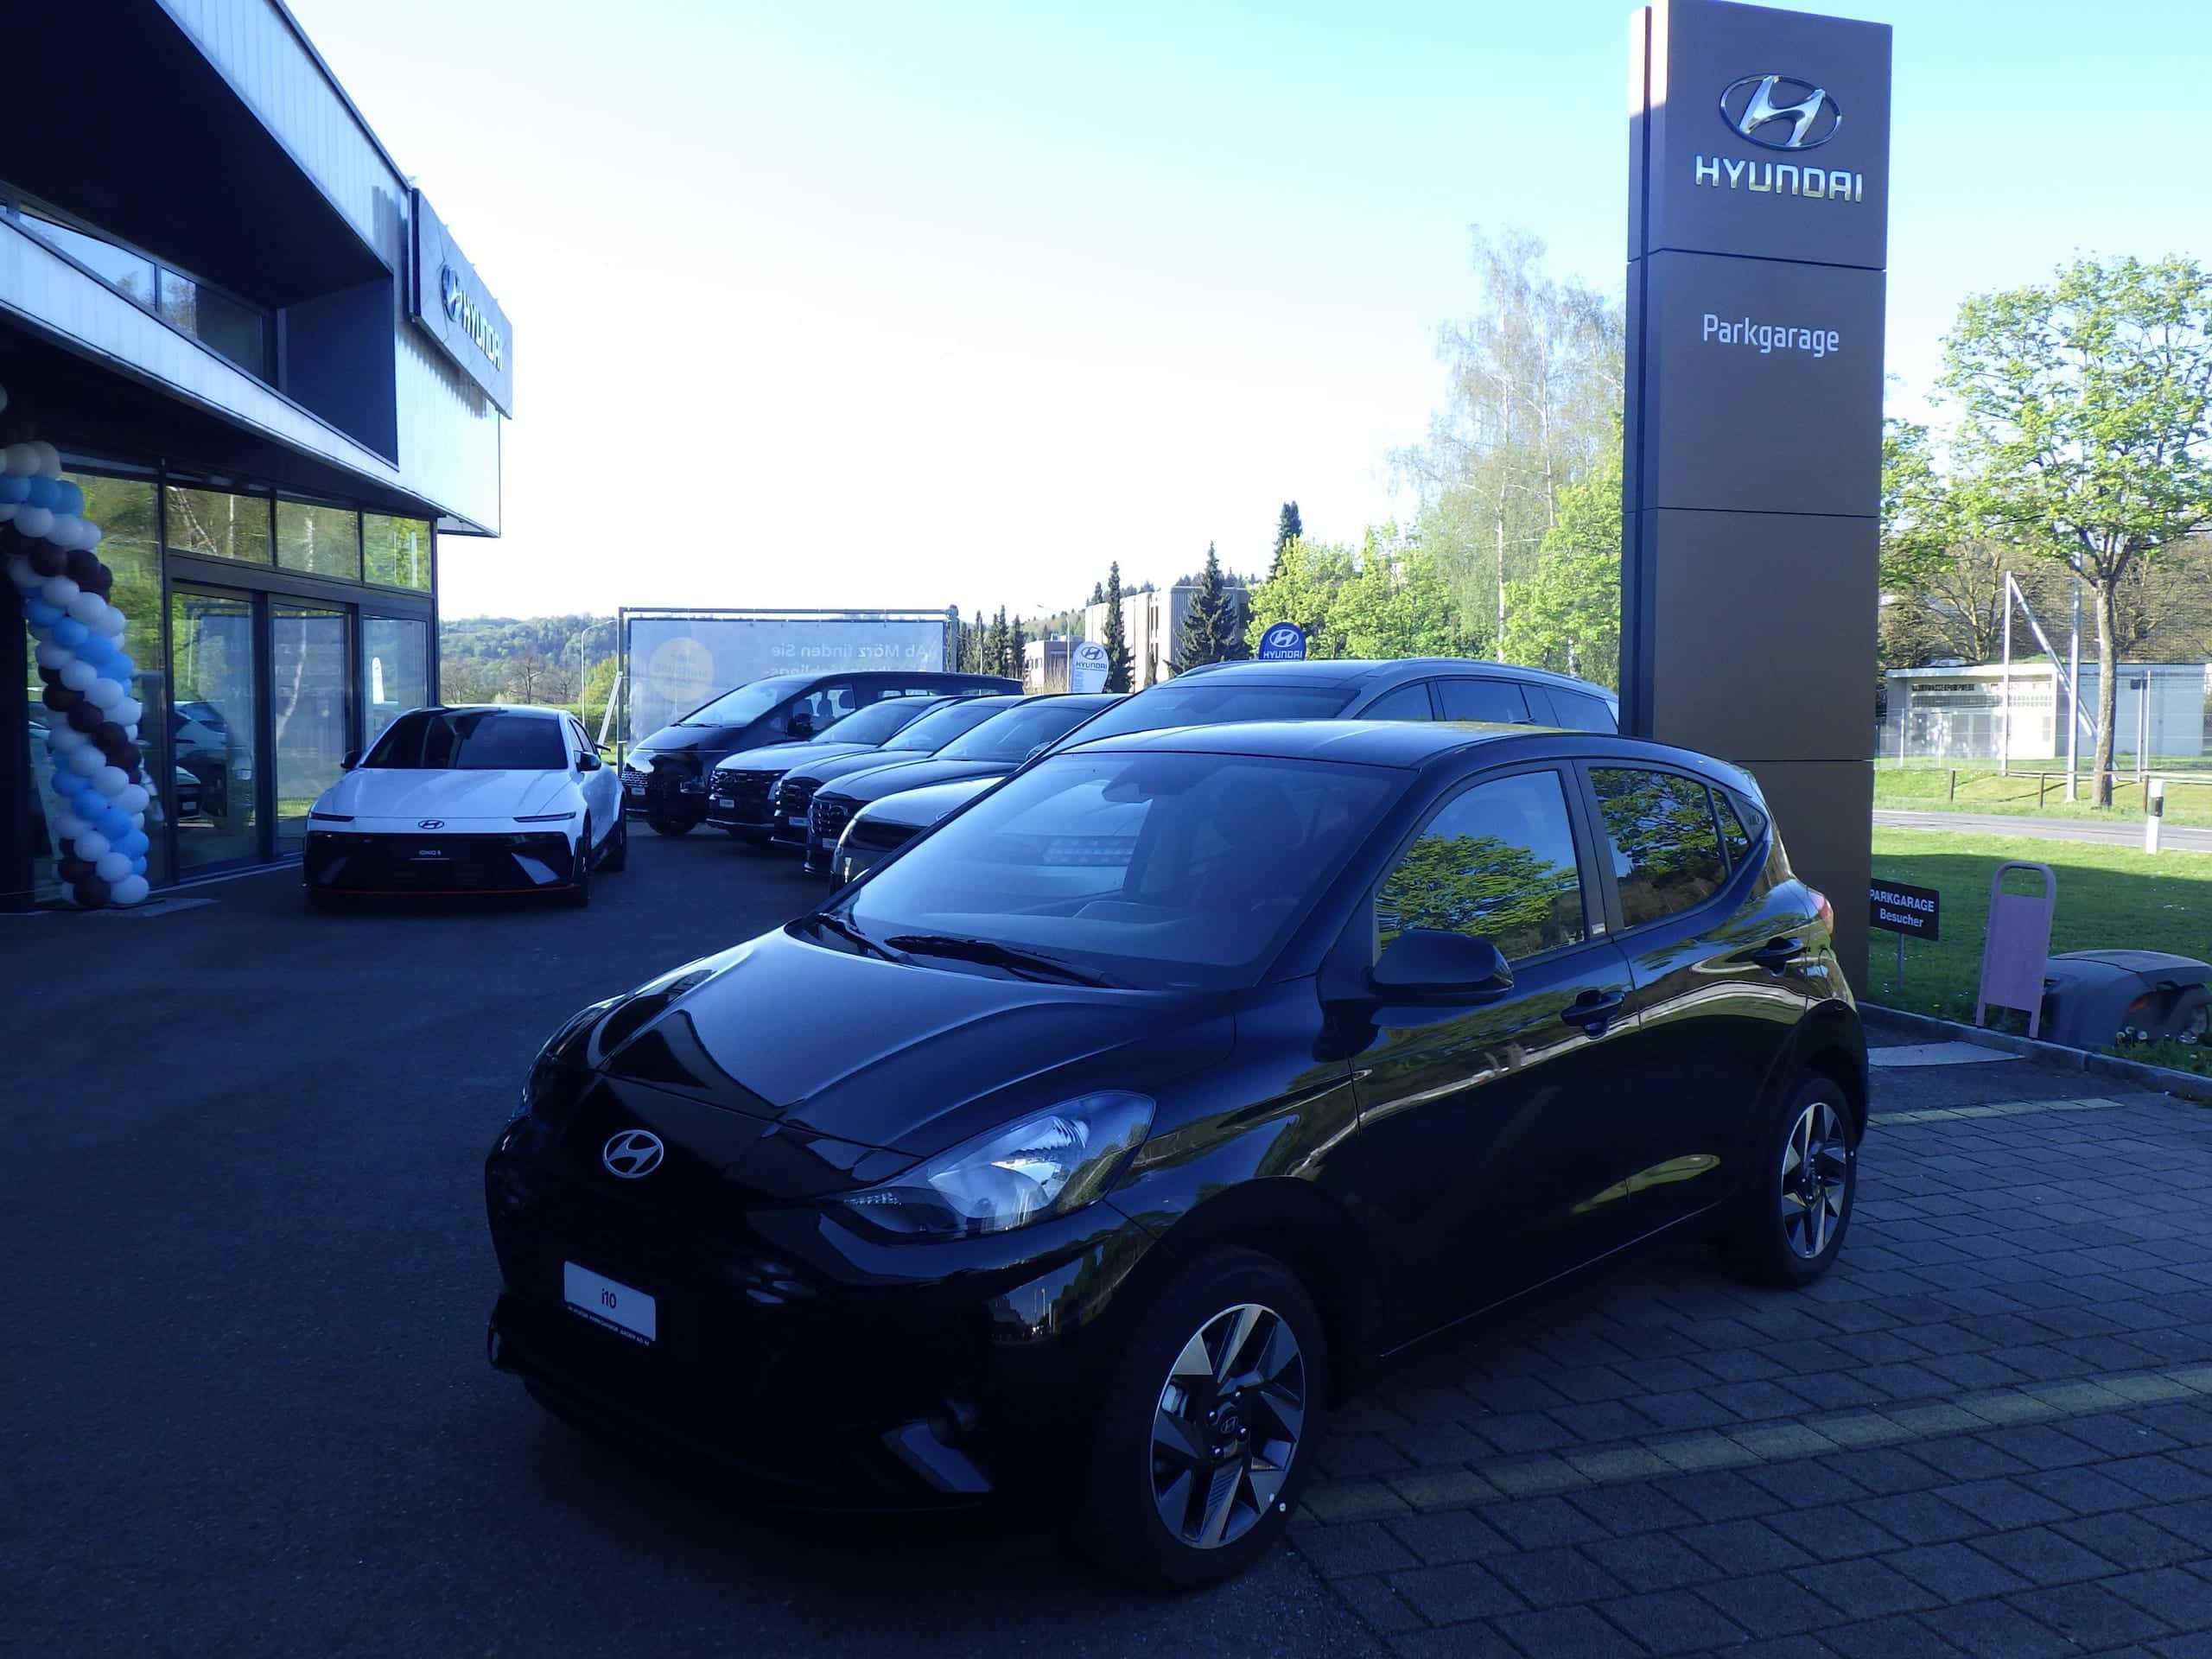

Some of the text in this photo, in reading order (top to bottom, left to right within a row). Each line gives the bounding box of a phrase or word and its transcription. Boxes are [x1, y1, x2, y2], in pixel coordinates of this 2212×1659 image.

[1695, 155, 1864, 203] HYUNDAI
[461, 289, 504, 373] HYUNDAI
[1703, 314, 1840, 358] Parkgarage
[1263, 650, 1303, 659] HYUNDAI
[1869, 888, 1936, 913] PARKGARAGE
[1879, 907, 1924, 928] Besucher
[601, 1287, 617, 1310] i10
